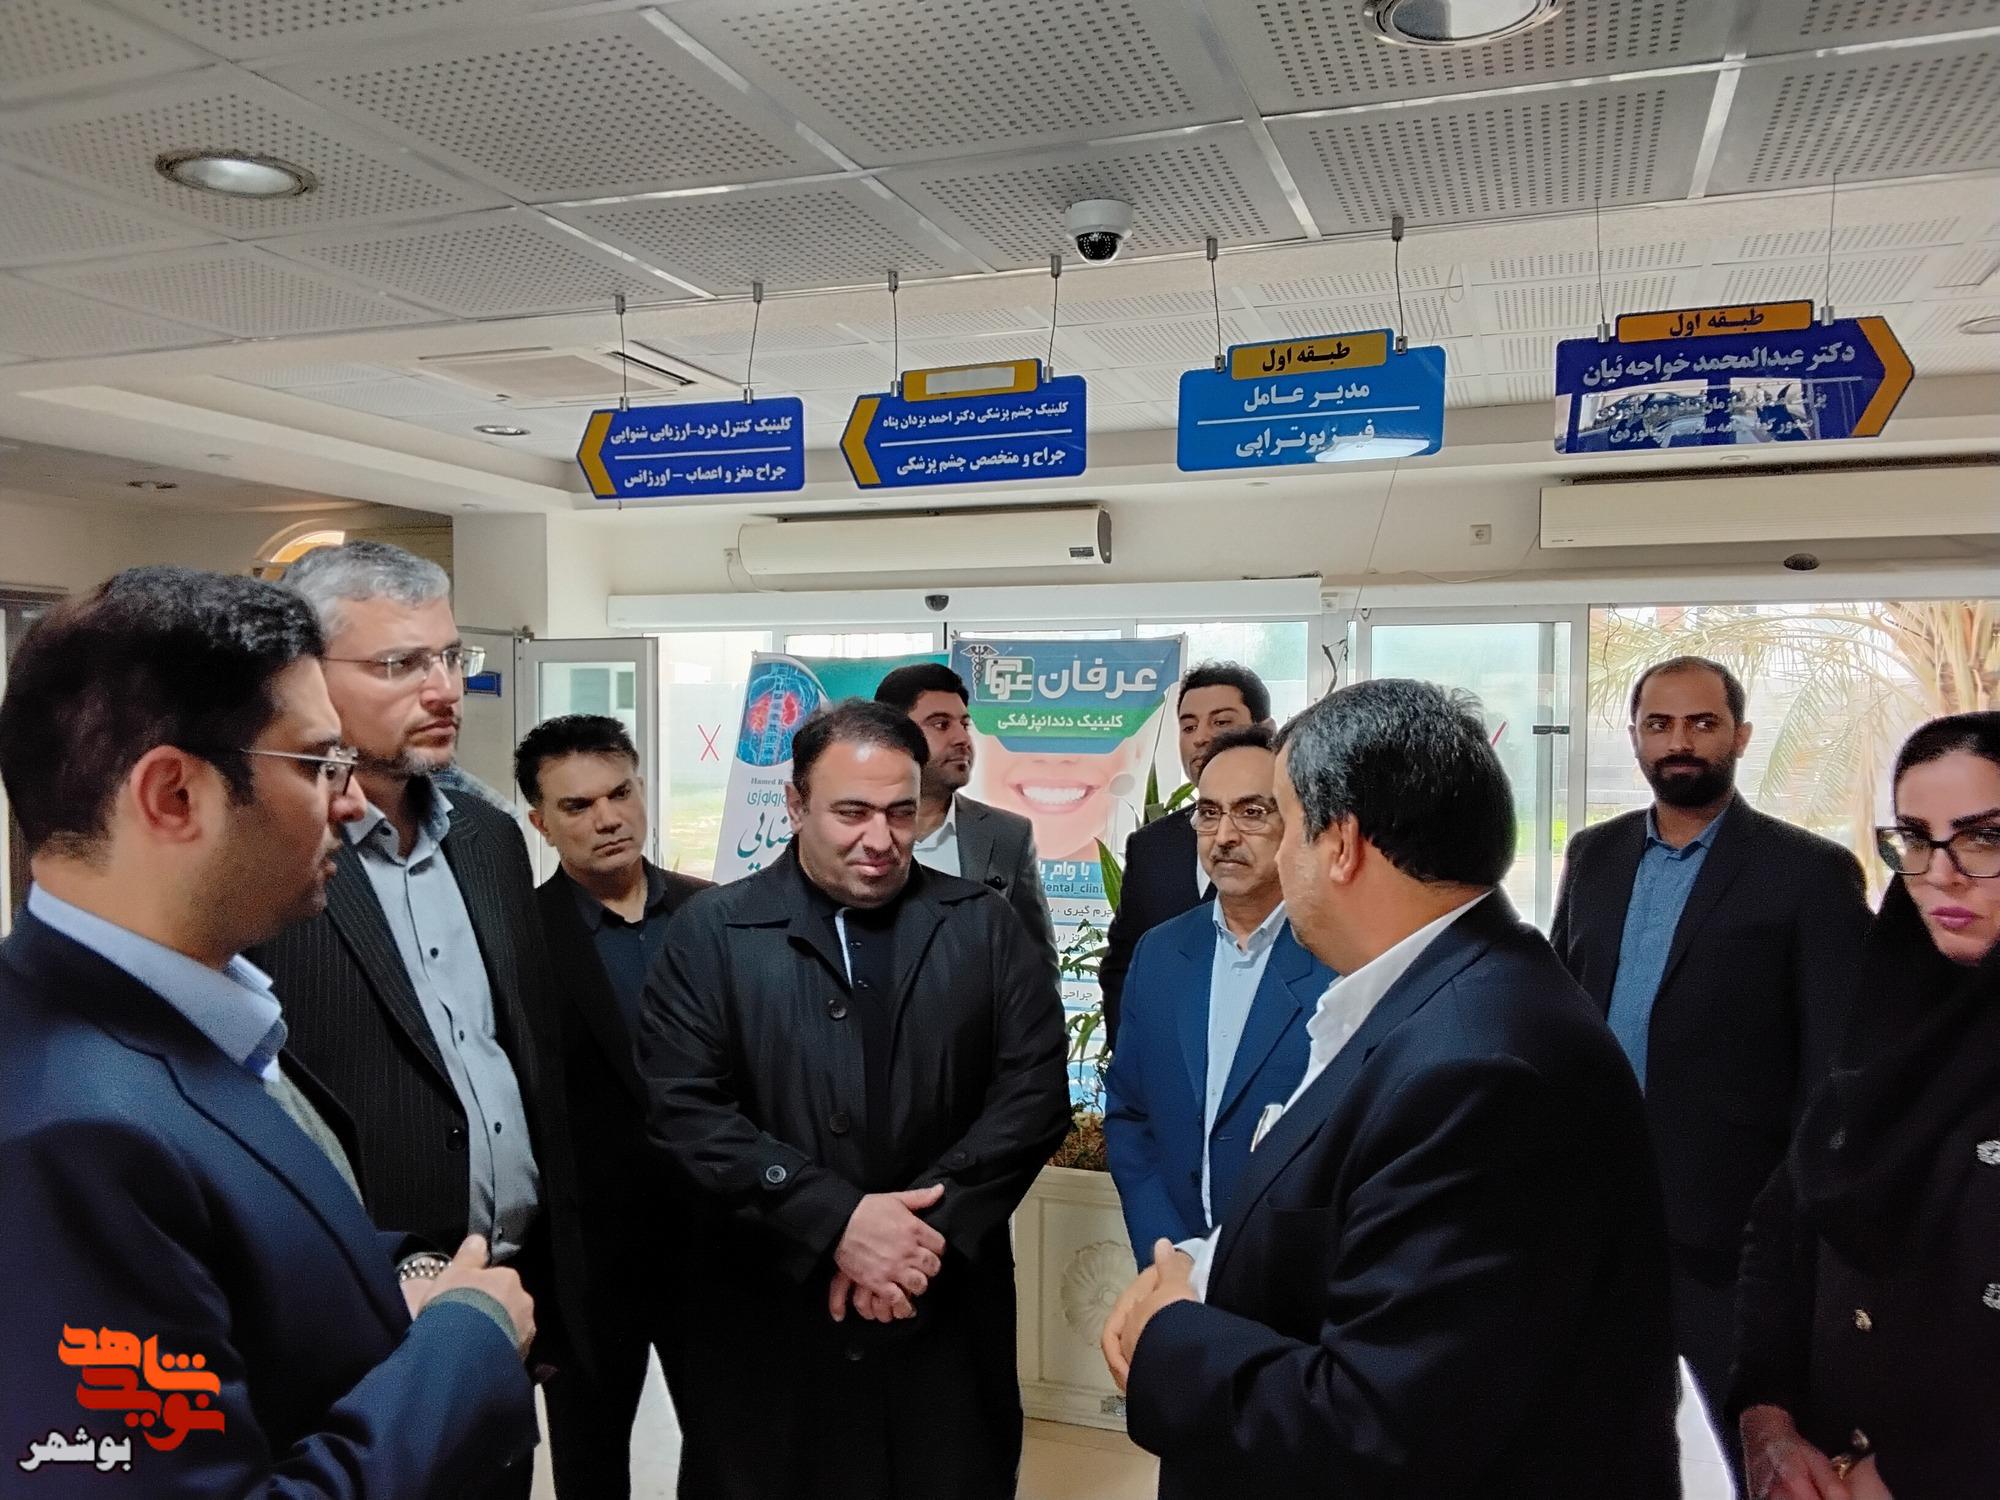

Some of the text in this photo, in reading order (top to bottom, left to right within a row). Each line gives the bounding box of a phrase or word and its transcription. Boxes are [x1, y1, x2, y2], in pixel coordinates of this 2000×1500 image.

[1669, 309, 1764, 337] طبقه اول
[1262, 341, 1350, 372] طبقه اول
[1693, 346, 1805, 373] عبدالمحمد
[1809, 341, 1856, 371] دکتر
[1243, 382, 1370, 412] مدیر عامل
[754, 416, 792, 434] کلینیک
[882, 401, 1069, 430] کلینیک چشم پزشکی دکتر احمد یزدان پناه
[610, 425, 648, 444] شنوایی
[723, 419, 752, 438] کنترل
[896, 447, 1066, 475] جراح و متخصص چشم پزشکی
[624, 467, 671, 488] اورژانس
[685, 465, 723, 484] اعصاب
[724, 471, 732, 483] و
[735, 467, 754, 482] مغز
[756, 463, 787, 480] جراح
[1038, 657, 1158, 700] عرفان
[997, 713, 1124, 733] کلینیک دندانپزشکی
[1050, 861, 1076, 881] وام
[1081, 862, 1090, 880] با
[1043, 882, 1103, 895] ental_clini
[1063, 905, 1090, 917] گیری
